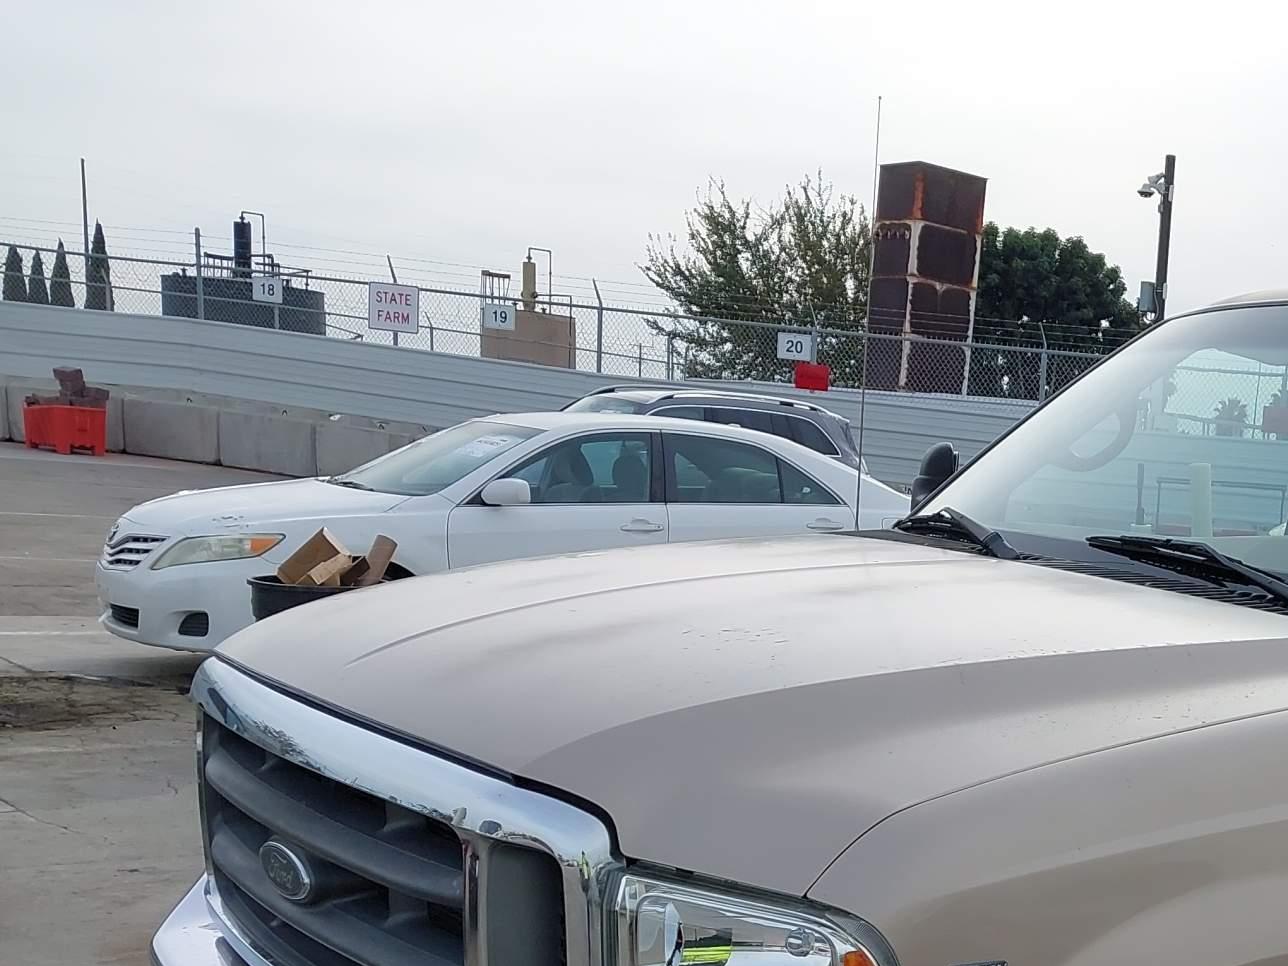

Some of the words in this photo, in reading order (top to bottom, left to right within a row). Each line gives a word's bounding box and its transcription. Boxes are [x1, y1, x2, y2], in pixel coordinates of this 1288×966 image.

[260, 282, 275, 297] 18
[375, 290, 412, 307] STATE
[377, 309, 410, 325] FARM
[492, 310, 508, 324] 19
[785, 339, 804, 354] 20
